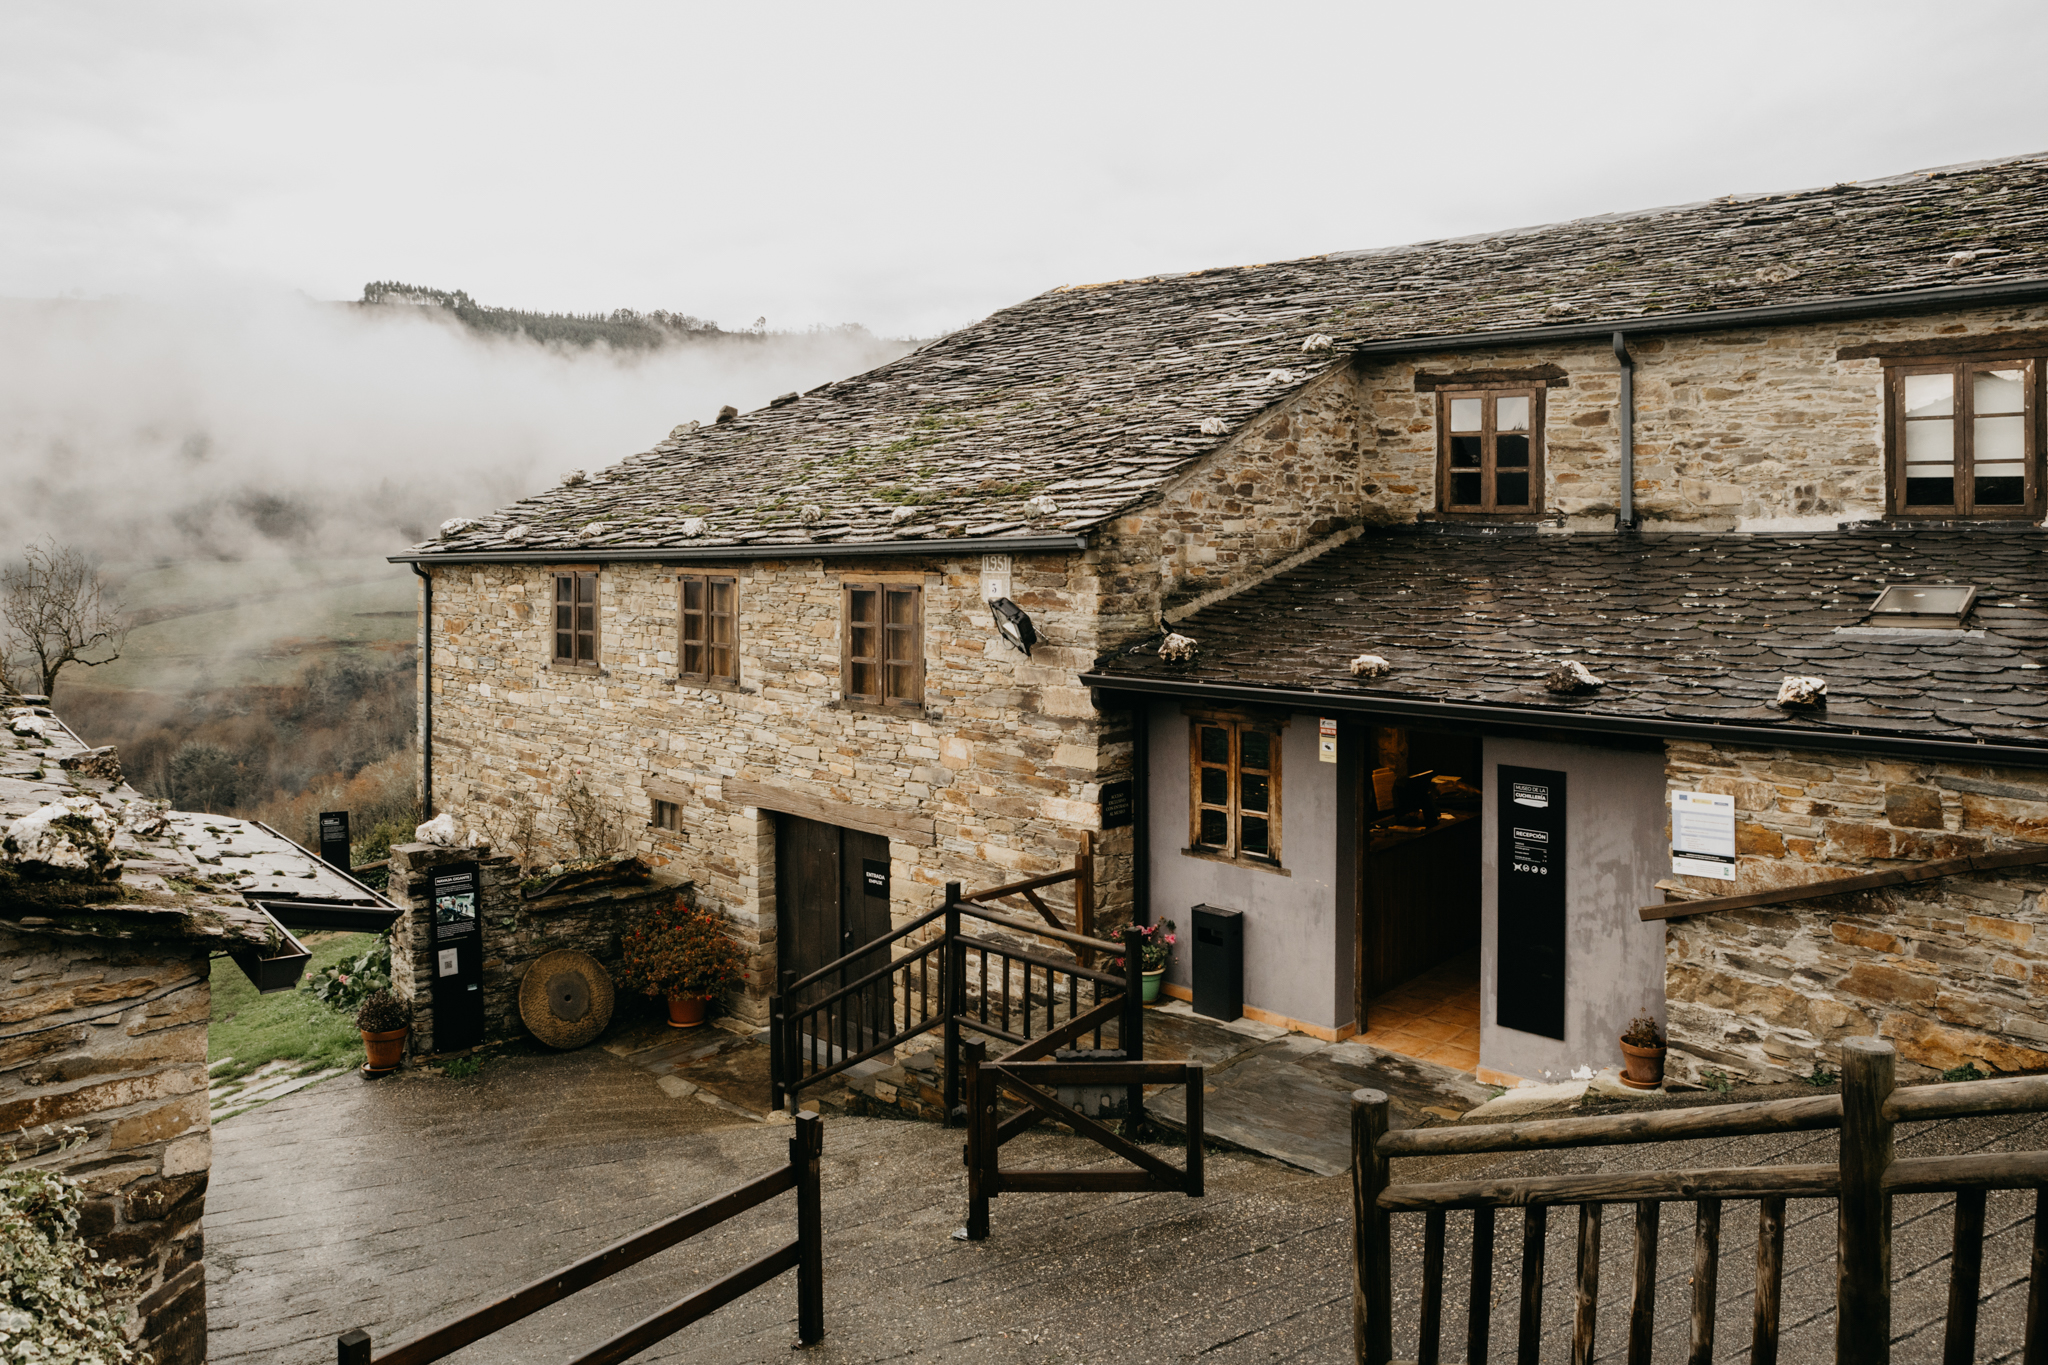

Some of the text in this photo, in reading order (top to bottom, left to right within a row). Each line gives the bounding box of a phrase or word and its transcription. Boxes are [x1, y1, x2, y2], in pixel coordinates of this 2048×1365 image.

[984, 556, 1007, 571] 1951
[1515, 792, 1546, 800] CUCHILLERÍA
[1516, 831, 1546, 840] RECEPCIÓN
[866, 871, 886, 880] ENTRADA
